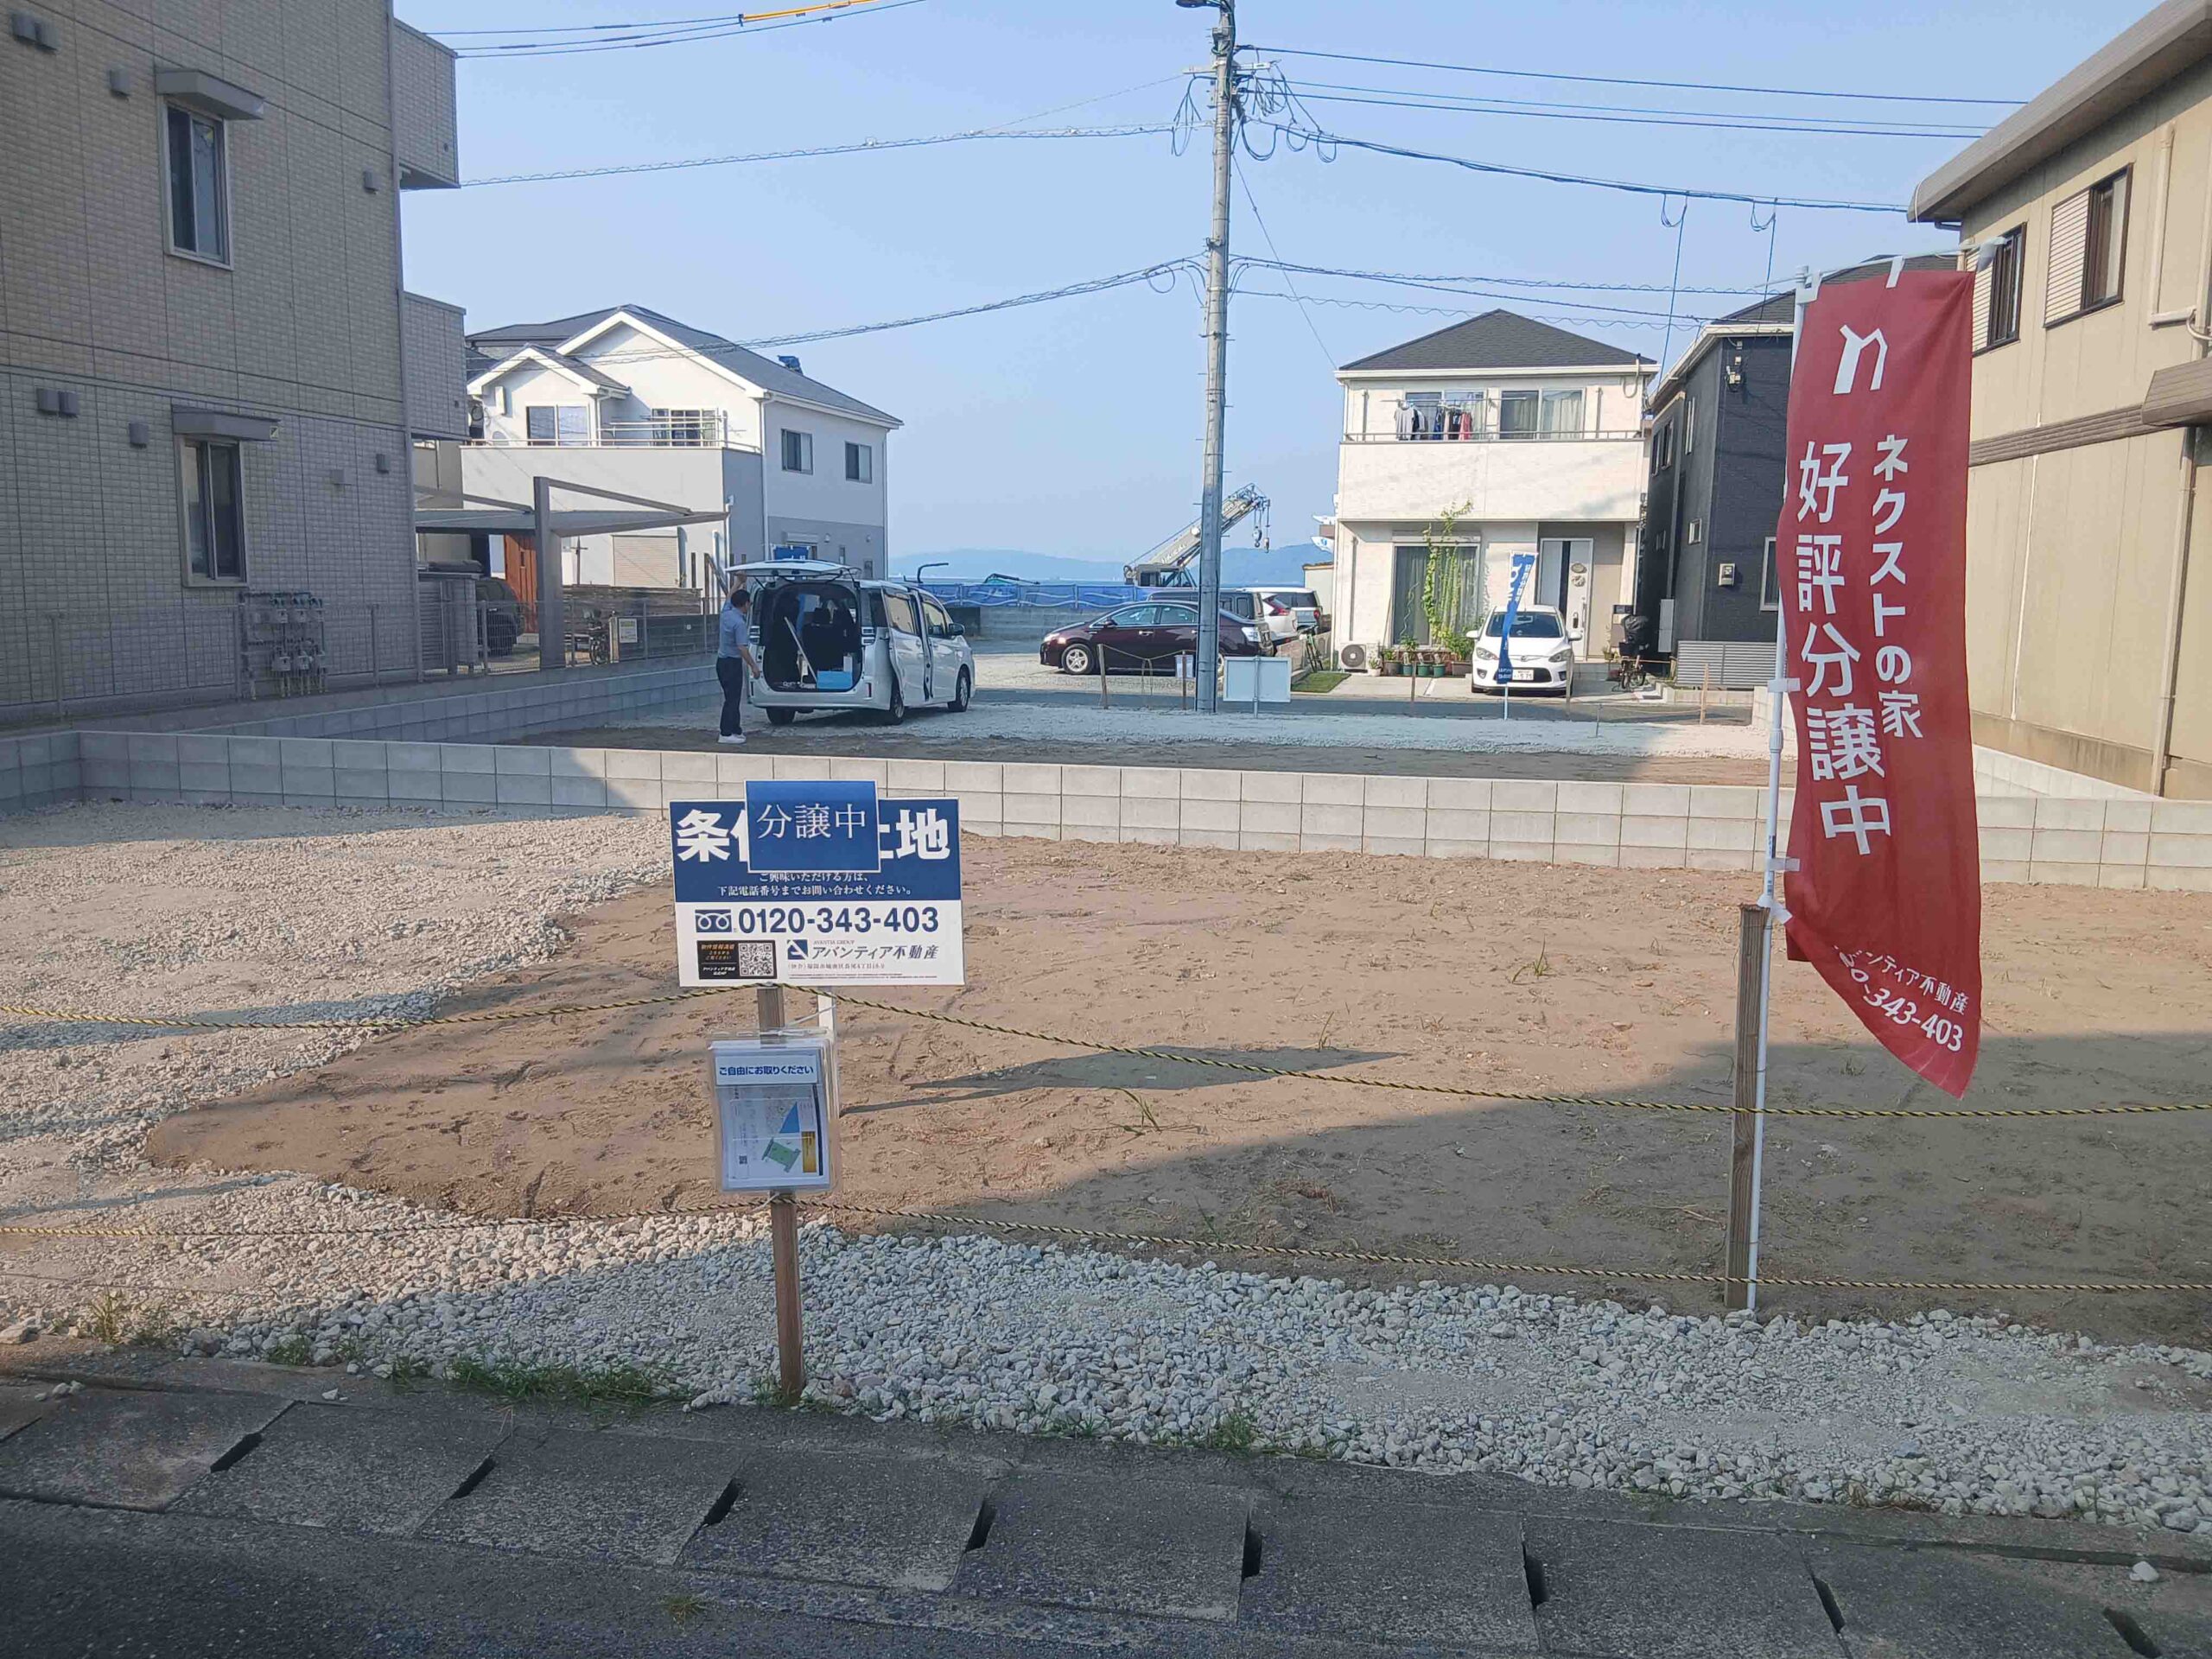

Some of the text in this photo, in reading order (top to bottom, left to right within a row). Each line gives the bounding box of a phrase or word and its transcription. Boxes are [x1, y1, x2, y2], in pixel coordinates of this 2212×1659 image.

[1870, 434, 1923, 739] ネクストの家
[1796, 440, 1891, 856] 好評分譲中
[757, 804, 867, 840] 分譲中
[718, 885, 912, 897] 下記電話番号までお問い合わせください。
[739, 907, 938, 933] 0120-343-403
[811, 944, 939, 960] アバンティア不動産
[719, 1065, 814, 1076] ご自由にお取りください
